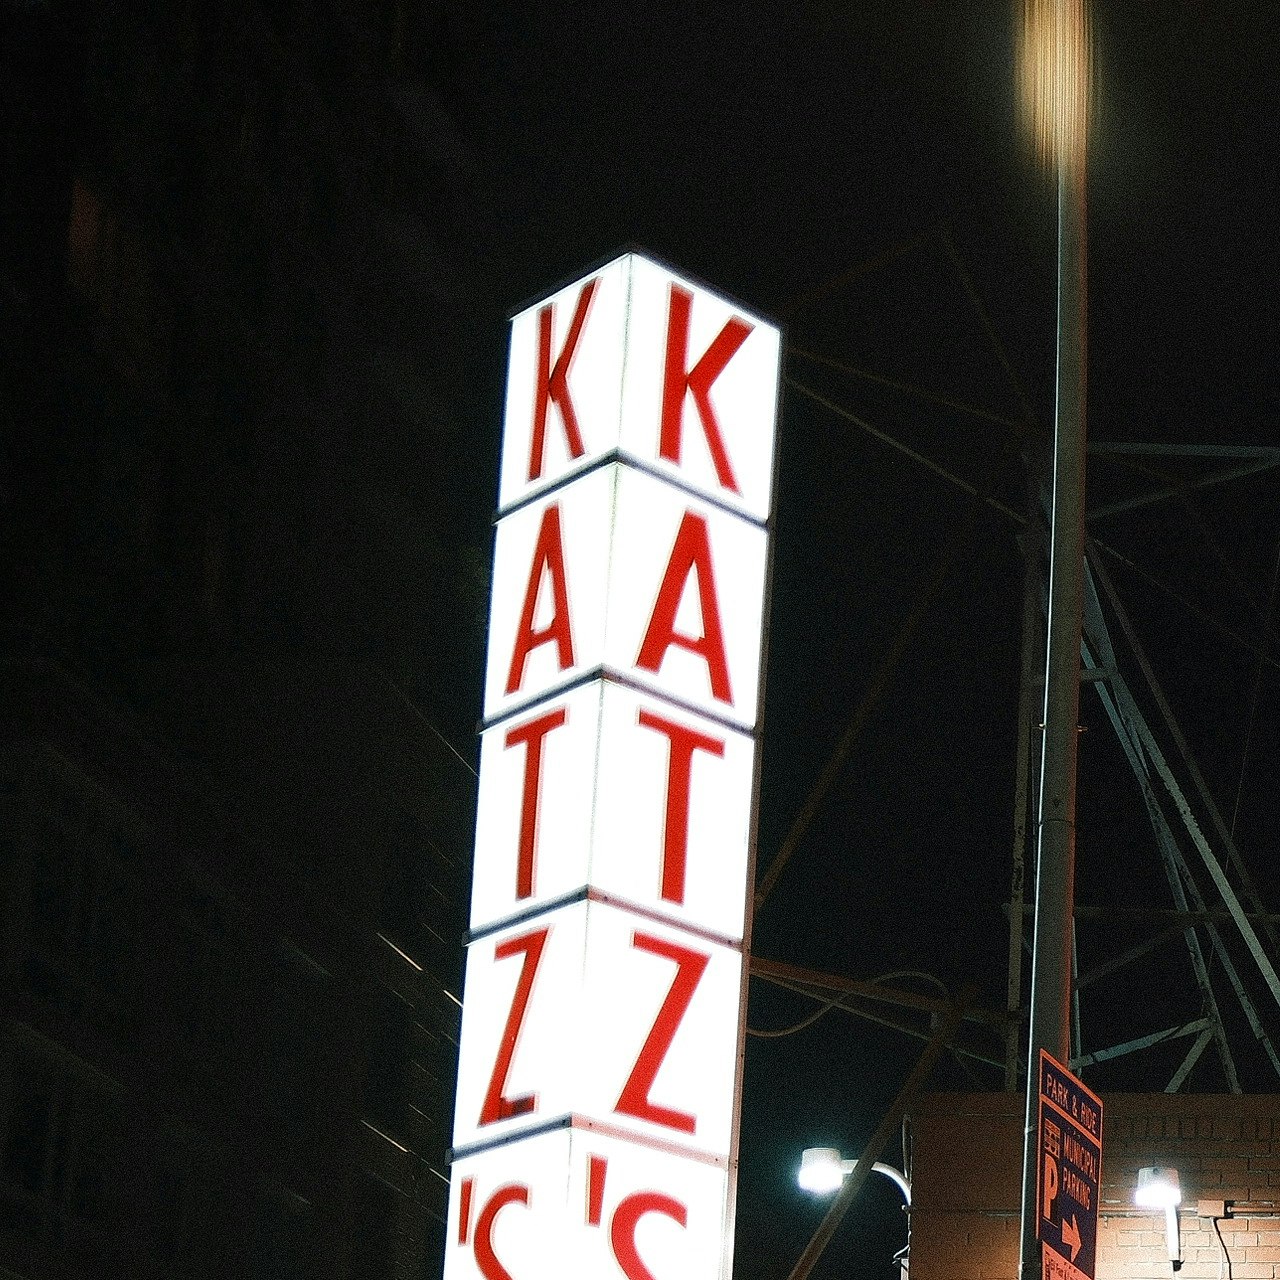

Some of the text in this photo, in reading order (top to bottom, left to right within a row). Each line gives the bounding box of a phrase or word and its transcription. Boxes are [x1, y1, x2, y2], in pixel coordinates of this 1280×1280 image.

[1046, 1073, 1097, 1135] PARK & RIDE
[1063, 1132, 1098, 1184] MUNICIPAL
[1062, 1166, 1091, 1211] PARKING
